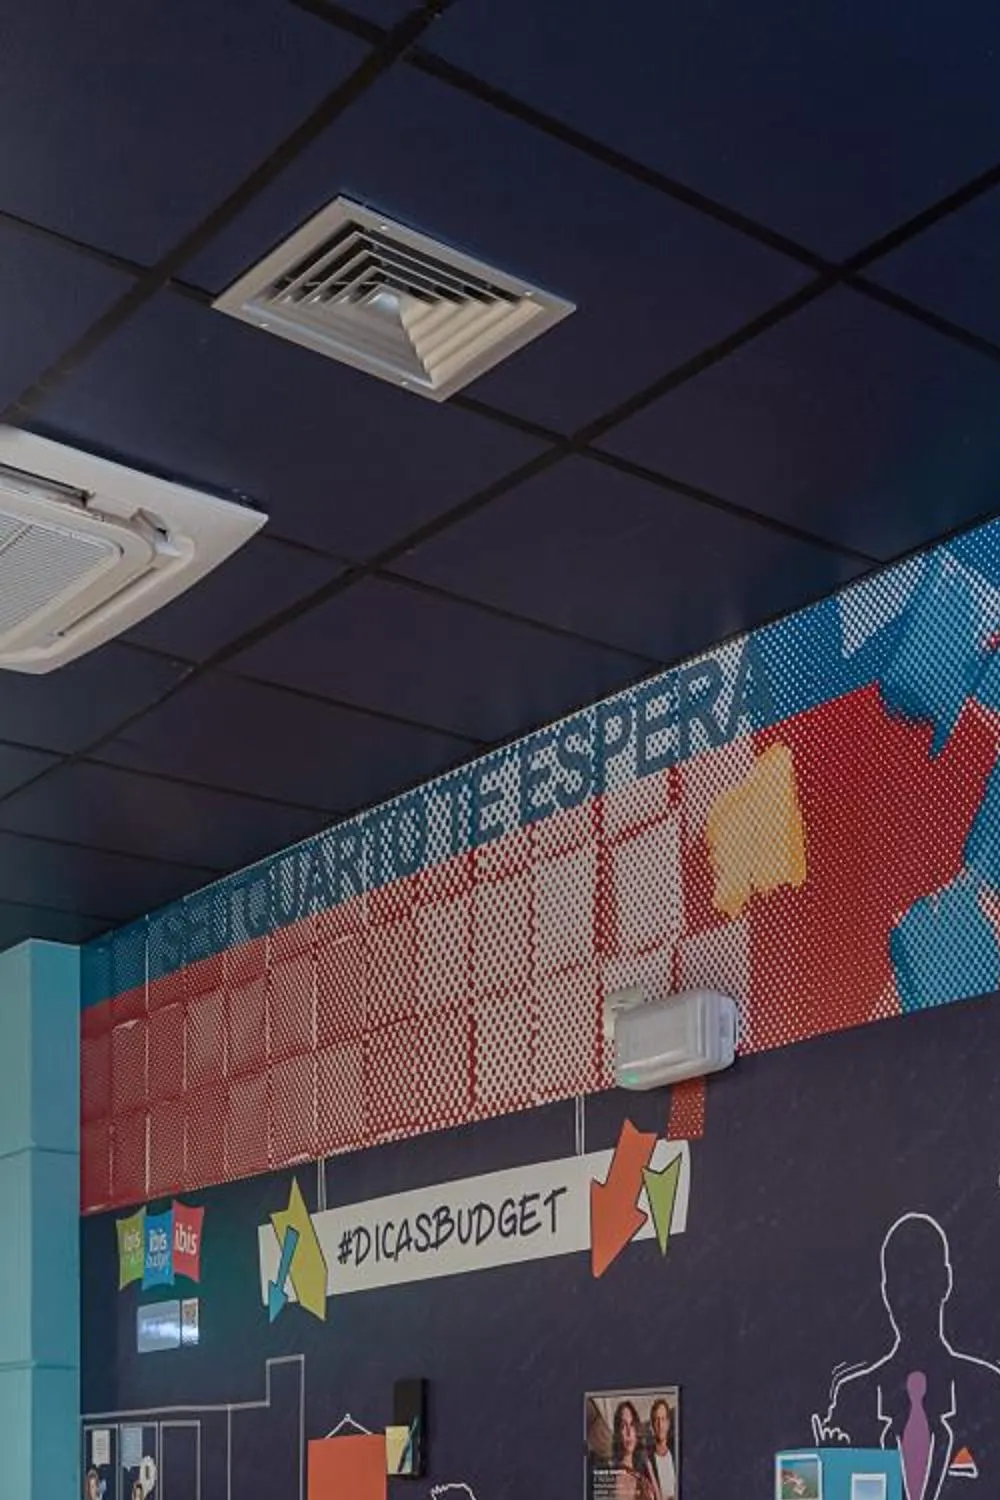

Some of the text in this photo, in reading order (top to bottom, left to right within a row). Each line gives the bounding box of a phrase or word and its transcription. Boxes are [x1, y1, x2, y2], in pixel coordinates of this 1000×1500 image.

[242, 786, 428, 935] QUARTO
[430, 752, 502, 850] TE
[520, 640, 776, 824] ESPERA
[174, 1222, 197, 1255] ibis
[337, 1187, 568, 1266] #DICASBUDGET
